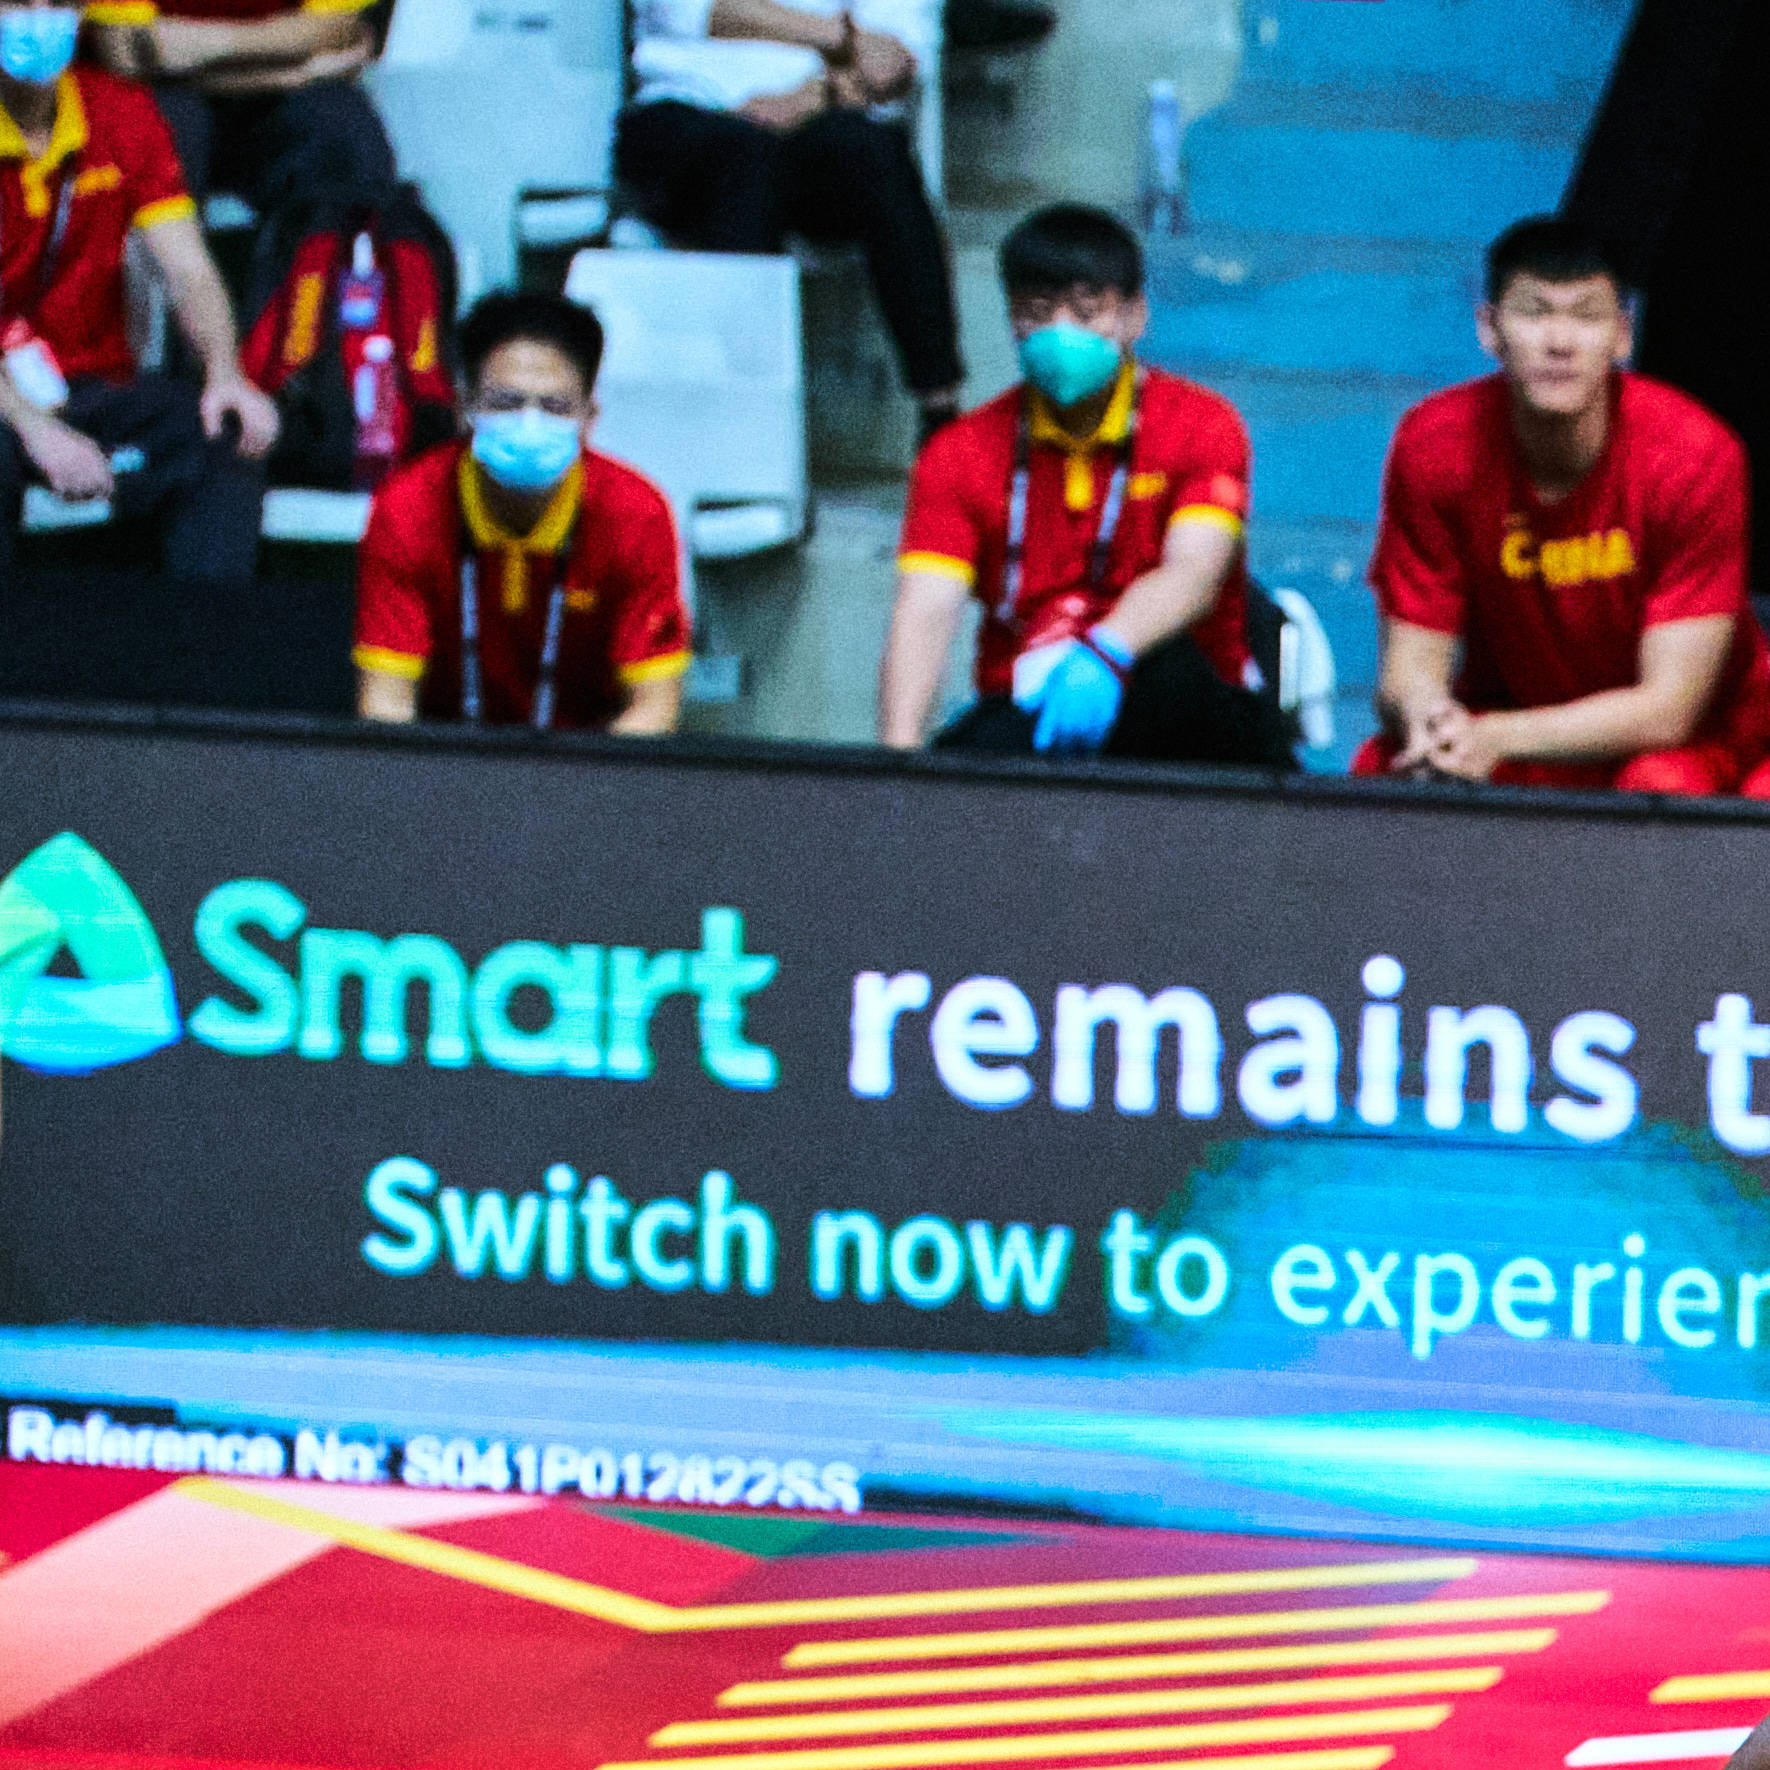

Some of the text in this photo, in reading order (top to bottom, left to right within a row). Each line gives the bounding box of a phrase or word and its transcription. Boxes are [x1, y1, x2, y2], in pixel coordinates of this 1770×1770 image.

[190, 877, 780, 1090] Smart
[846, 954, 1643, 1143] remains
[360, 1156, 776, 1296] Switch
[810, 1210, 1073, 1315] now
[1102, 1208, 1230, 1318] to
[6, 1403, 286, 1478] Reference
